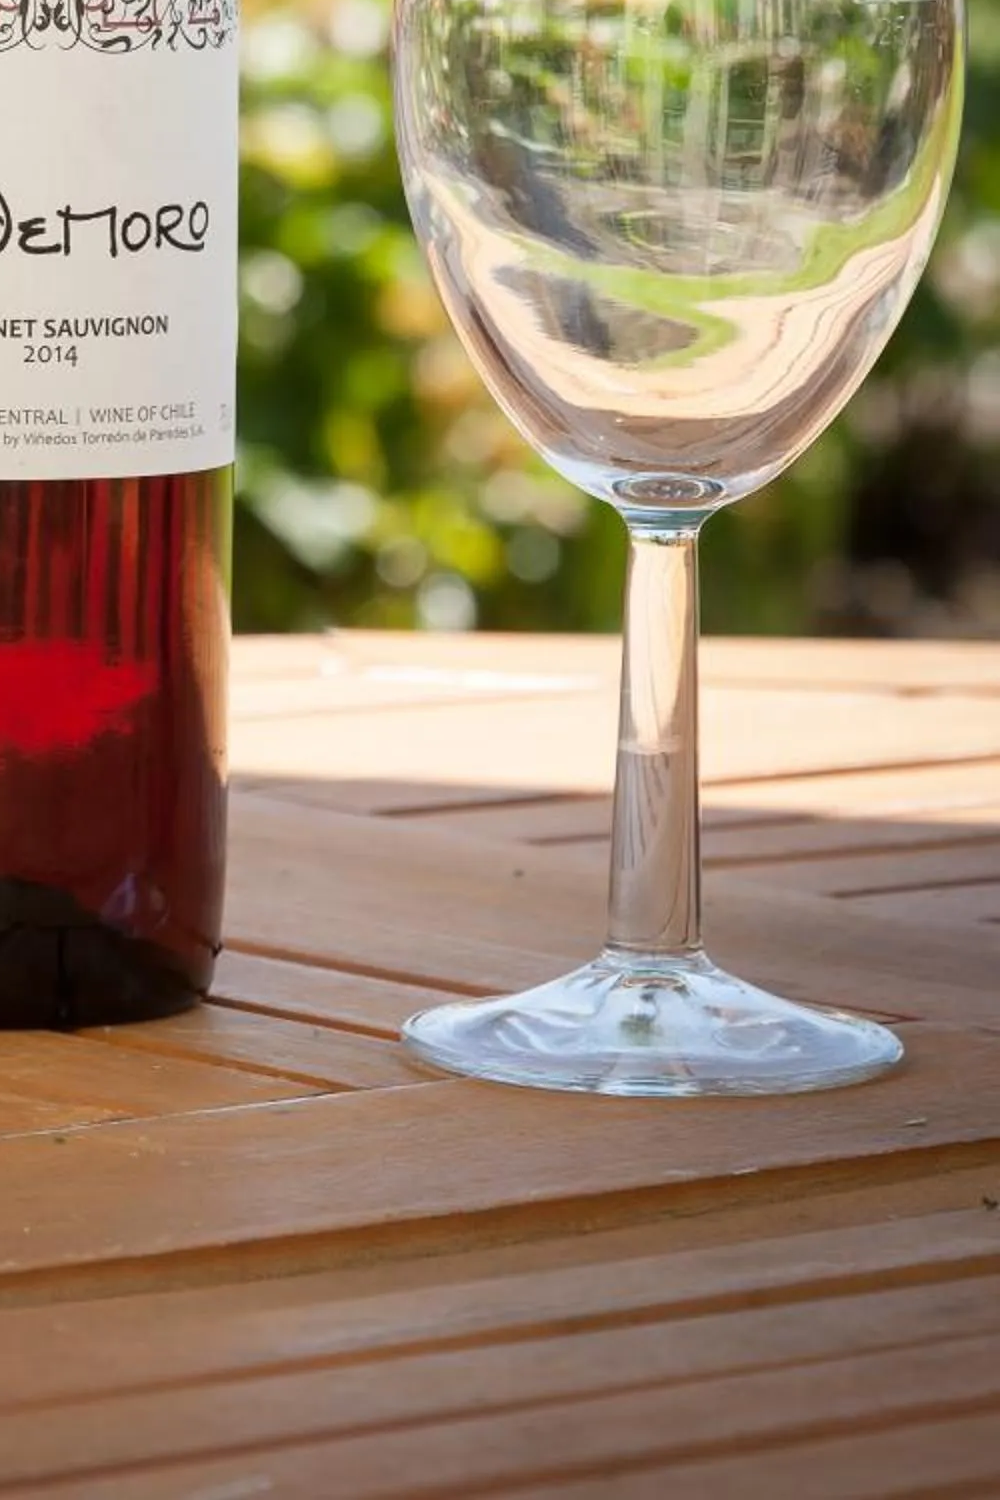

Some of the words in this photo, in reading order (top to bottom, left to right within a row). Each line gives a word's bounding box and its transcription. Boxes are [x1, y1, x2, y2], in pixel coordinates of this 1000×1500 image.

[43, 315, 169, 338] SAUVIGNON
[23, 345, 78, 367] 2014
[89, 407, 133, 423] WINE
[137, 405, 157, 421] OF
[3, 432, 20, 448] by
